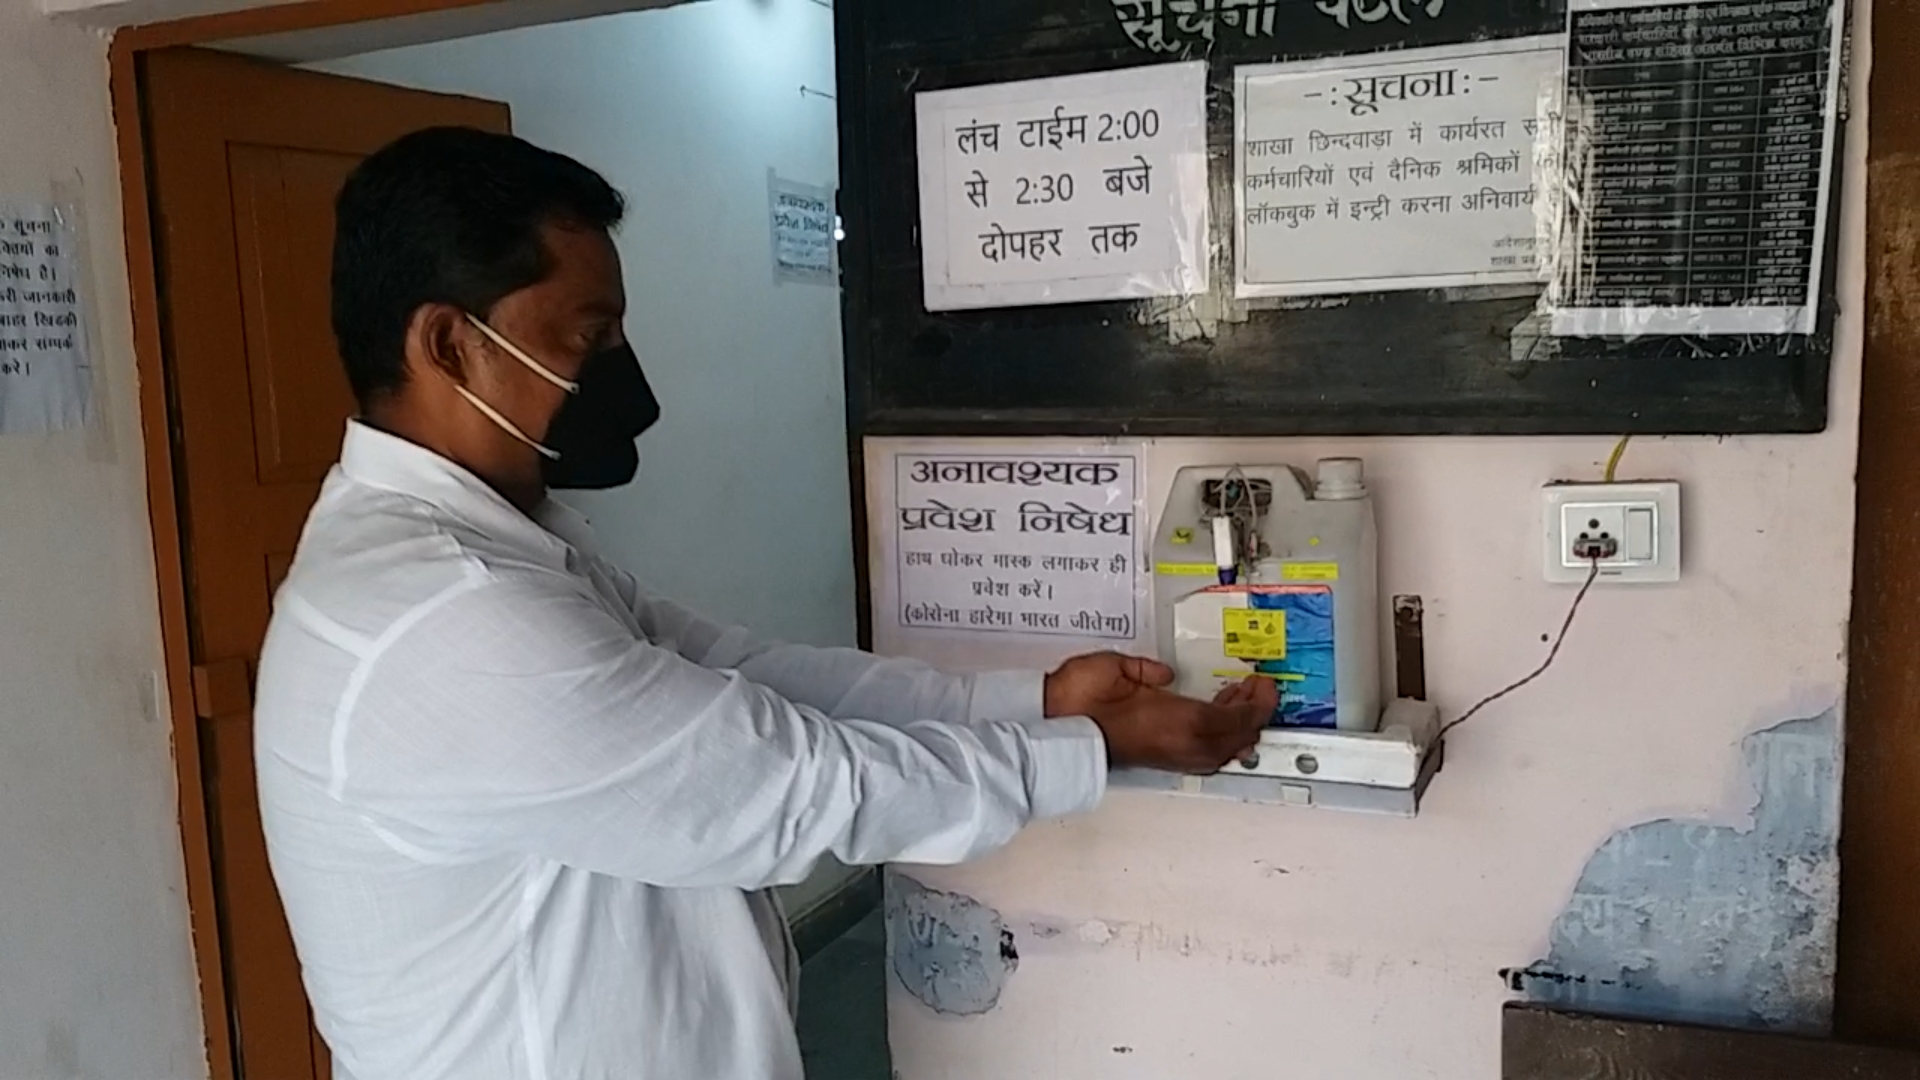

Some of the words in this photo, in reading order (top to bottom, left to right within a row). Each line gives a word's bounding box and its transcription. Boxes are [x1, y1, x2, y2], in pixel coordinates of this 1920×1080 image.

[956, 119, 1000, 154] लंच
[1017, 106, 1088, 150] टाईम
[1097, 109, 1159, 142] 2:00
[1247, 136, 1293, 157] शाखा
[1408, 121, 1423, 144] में
[1439, 116, 1506, 142] कार्यरत
[965, 170, 989, 208] से
[1016, 173, 1074, 205] 2:30
[1103, 155, 1152, 196] बजे
[1247, 163, 1334, 191] कर्मचारियों
[1349, 160, 1374, 187] एवं
[1389, 158, 1441, 180] दैनिक
[1456, 150, 1521, 176] श्रमिकों
[1247, 201, 1316, 229] लॉकबुक
[1327, 197, 1340, 220] में
[1350, 193, 1391, 221] इन्ट्री
[1401, 195, 1451, 215] करना
[978, 222, 1063, 262] दोपहर
[1088, 223, 1141, 254] तक
[910, 461, 1120, 486] अनावश्यक
[900, 499, 997, 532] प्रवेश
[1018, 501, 1134, 536] निषेध
[905, 550, 932, 567] हाथ
[941, 548, 984, 568] धोकर
[993, 553, 1032, 569] मास्क
[1042, 556, 1099, 573] लगाकर
[1109, 554, 1127, 573] ही
[972, 576, 1009, 598] प्रवेश
[905, 603, 960, 625] (कोरोना
[969, 605, 1013, 626] हारेगा
[1020, 611, 1060, 628] भारत
[1070, 611, 1131, 635] जीतेगा)
